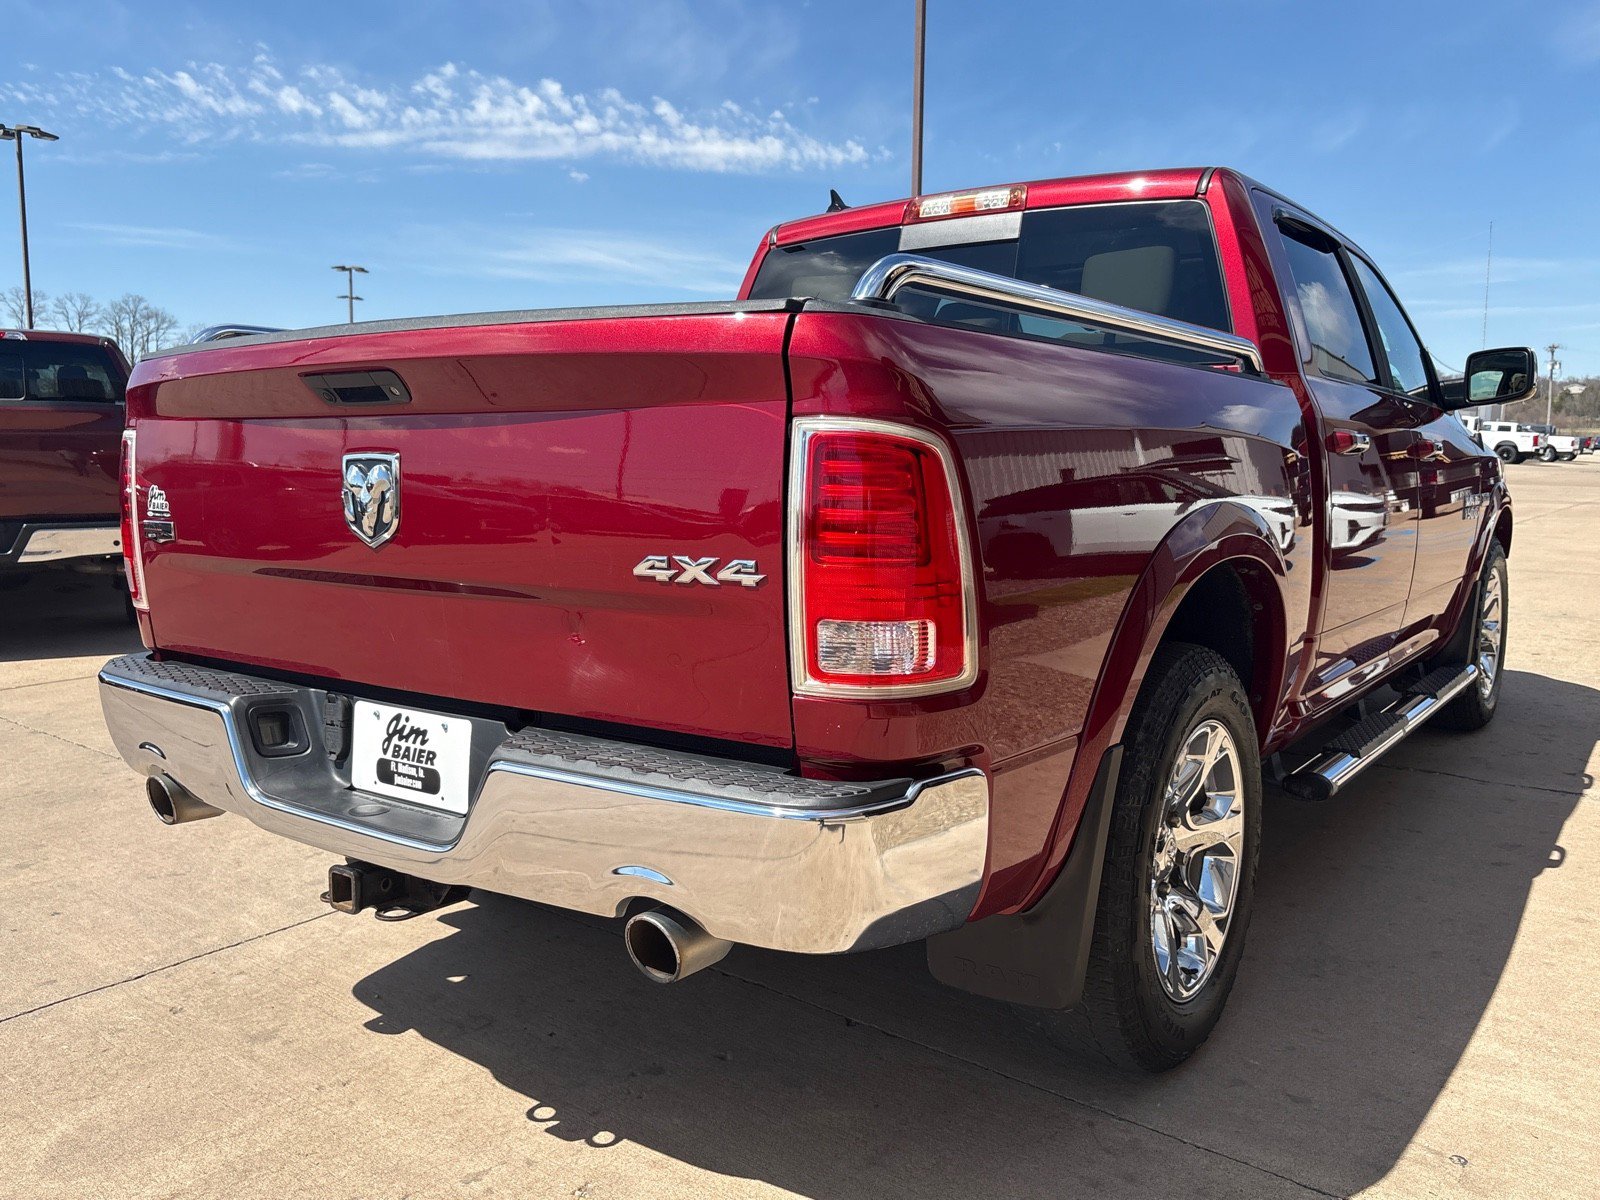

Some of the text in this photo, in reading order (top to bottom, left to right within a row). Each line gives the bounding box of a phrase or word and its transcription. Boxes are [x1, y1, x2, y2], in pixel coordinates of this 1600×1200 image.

[152, 501, 168, 510] BAIER
[632, 555, 767, 588] 4X4
[382, 712, 430, 756] Jim
[391, 743, 437, 766] BAIER
